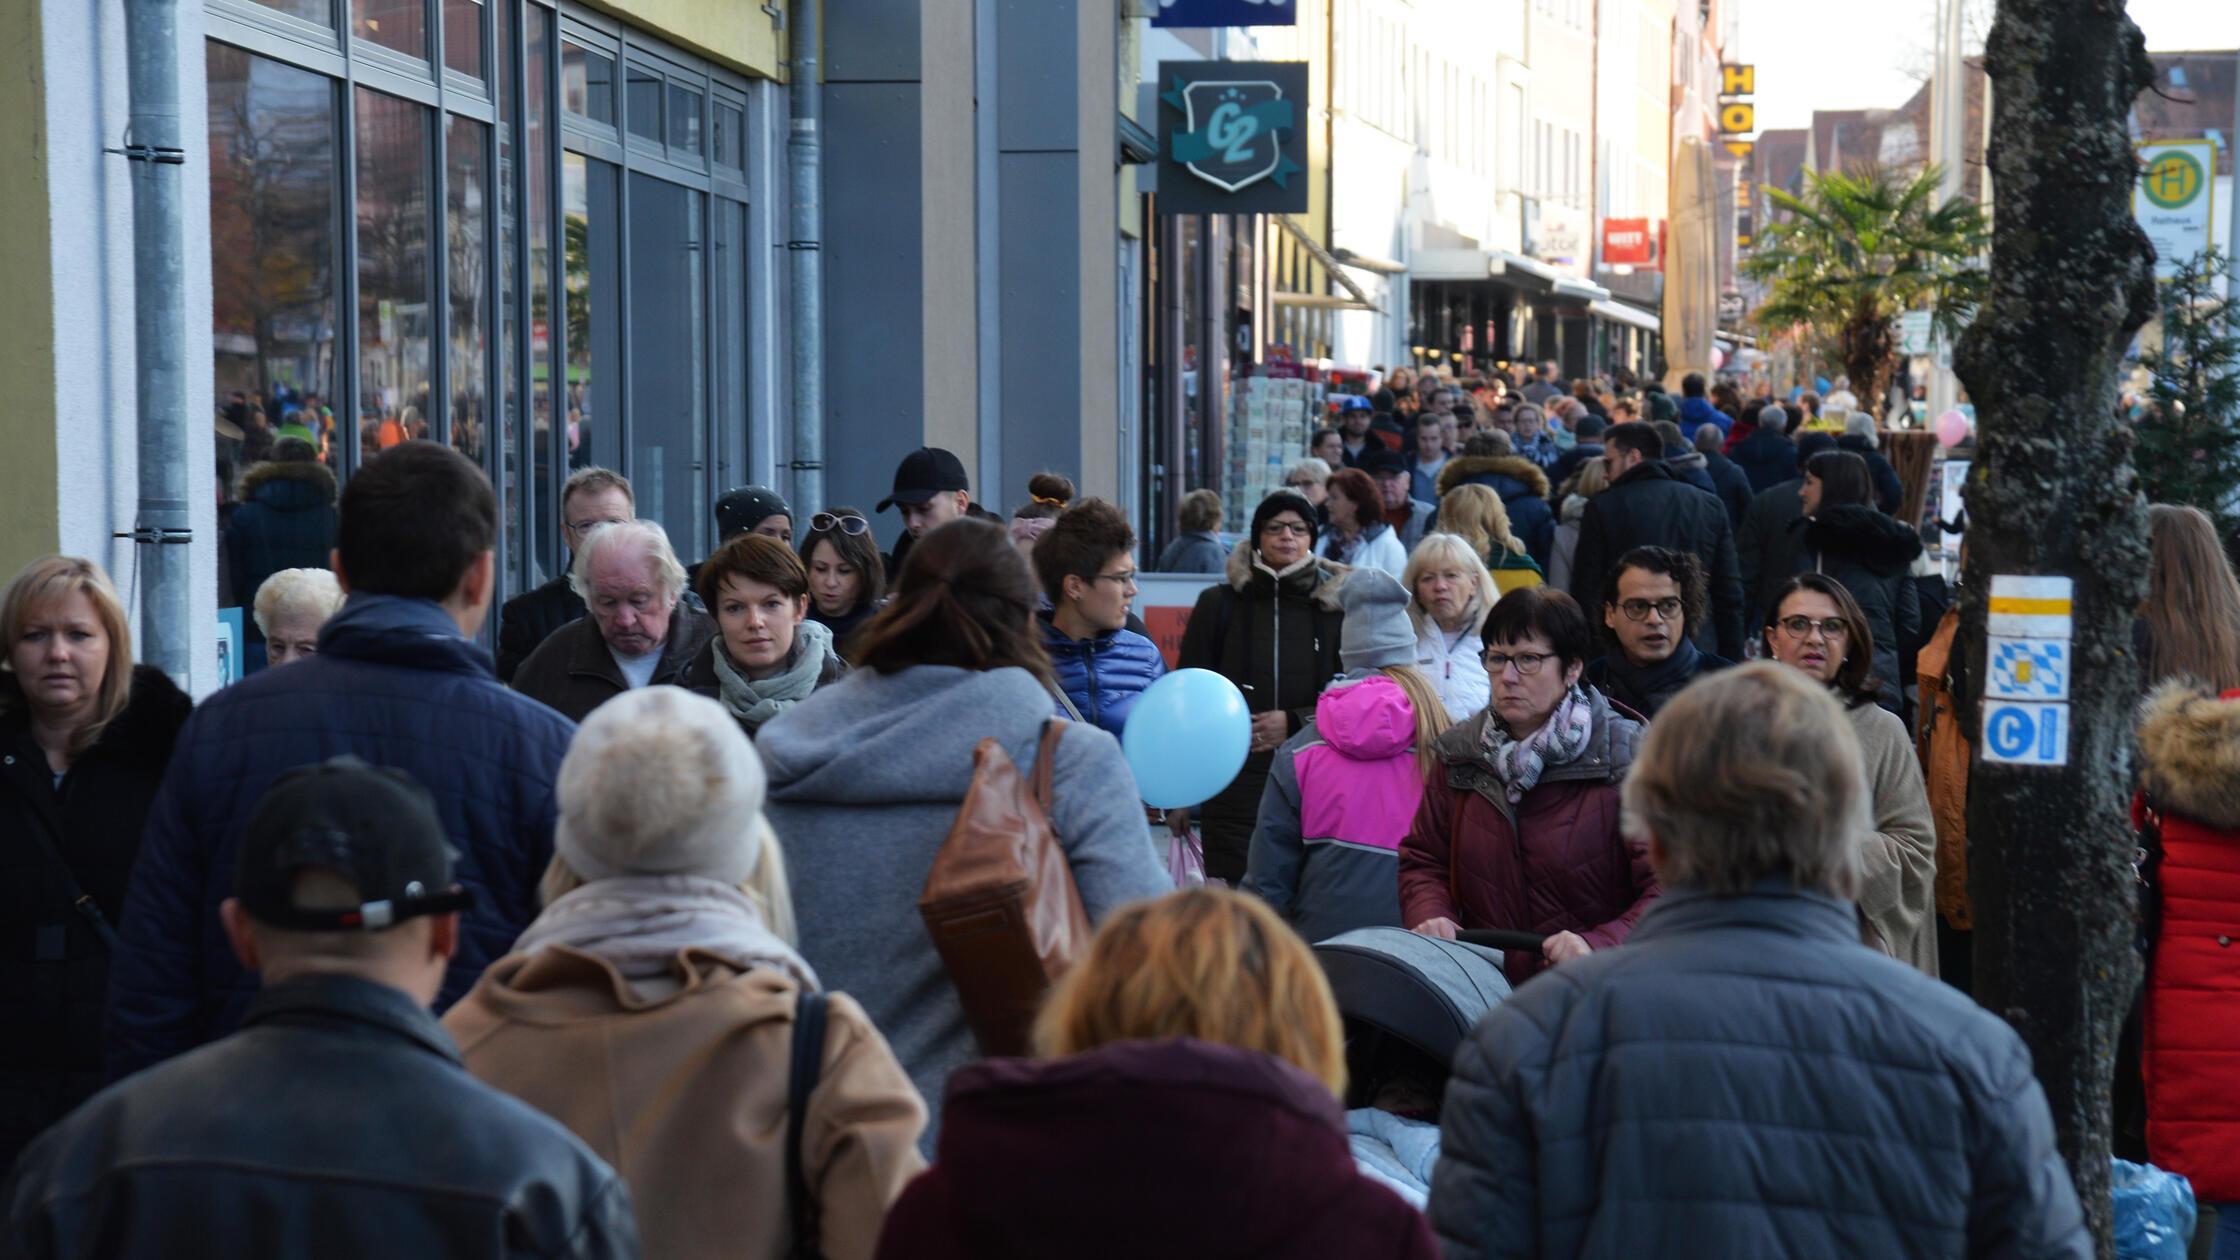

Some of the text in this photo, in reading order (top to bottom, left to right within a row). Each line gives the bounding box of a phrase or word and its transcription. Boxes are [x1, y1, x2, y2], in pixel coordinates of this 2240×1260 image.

[1207, 102, 1258, 164] G2
[2161, 160, 2185, 196] H
[1998, 714, 2021, 751] C
